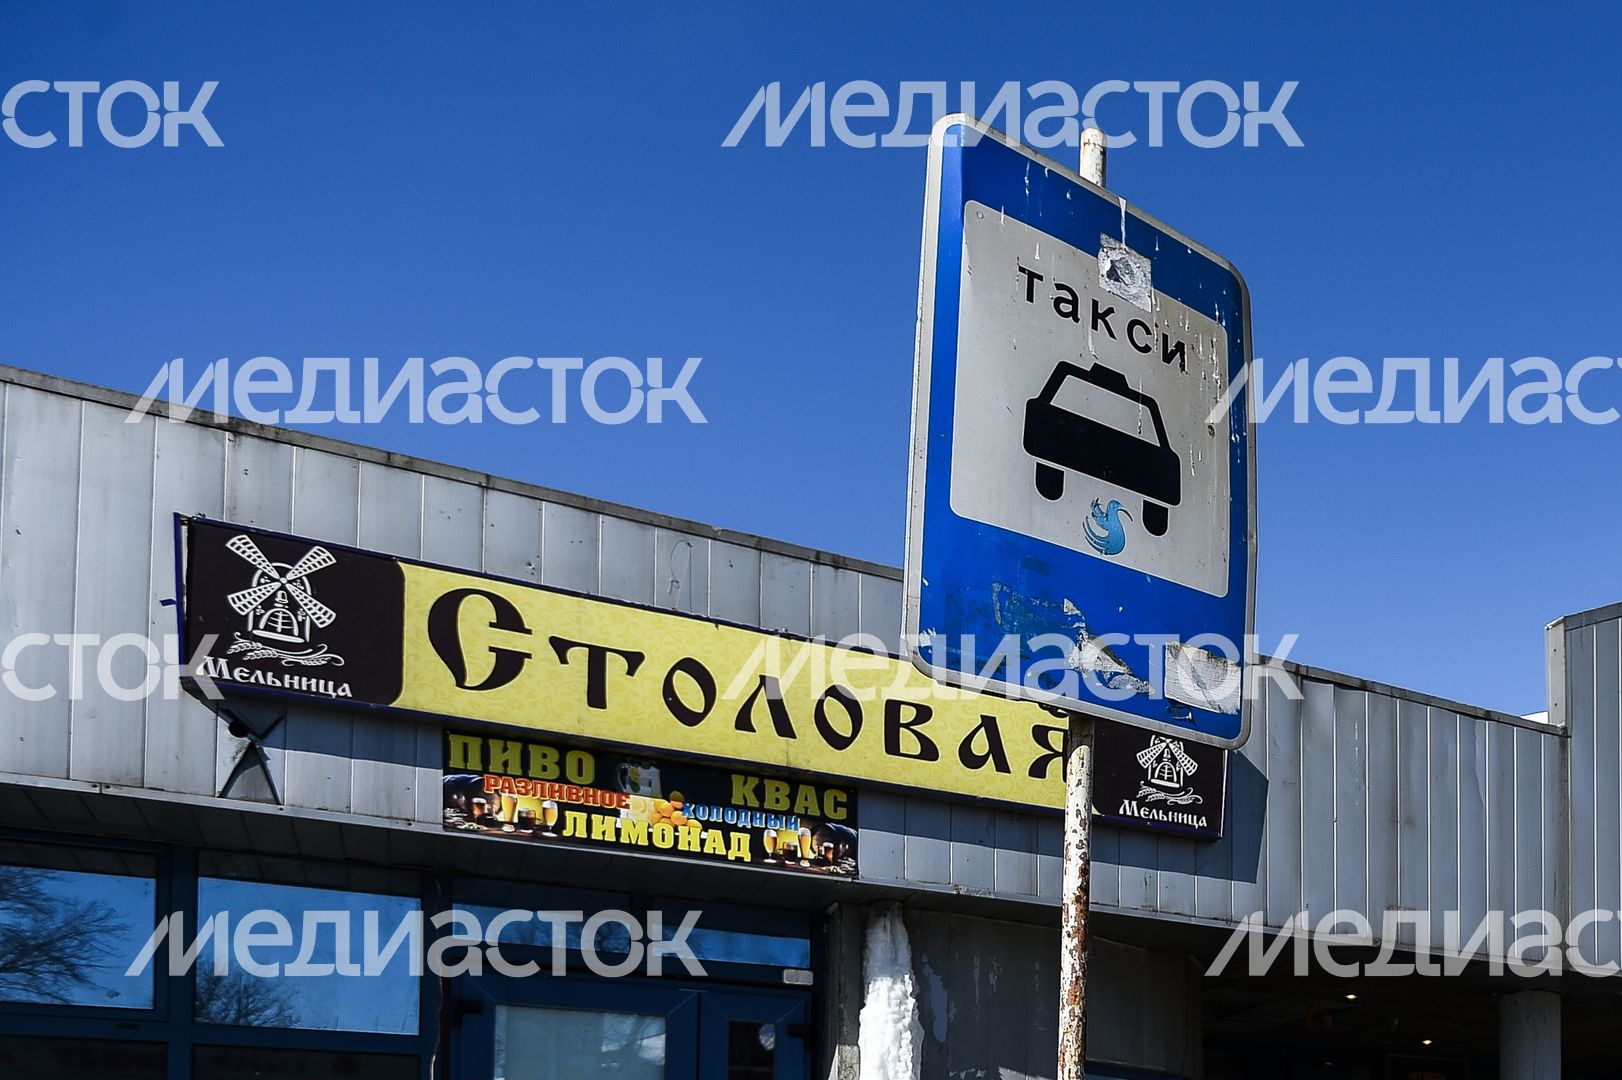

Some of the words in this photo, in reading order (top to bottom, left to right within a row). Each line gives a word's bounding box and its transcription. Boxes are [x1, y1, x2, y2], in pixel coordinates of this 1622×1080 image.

[1018, 264, 1190, 374] такси
[196, 656, 353, 699] Мельница
[448, 733, 596, 785] ПИВО
[484, 774, 630, 810] РАЗЛИВНОЕ
[730, 774, 848, 820] КВАС
[1118, 799, 1208, 829] Мельница
[563, 810, 752, 863] ЛИМОНАД
[683, 801, 802, 832] ХОЛОДНЫЙ
